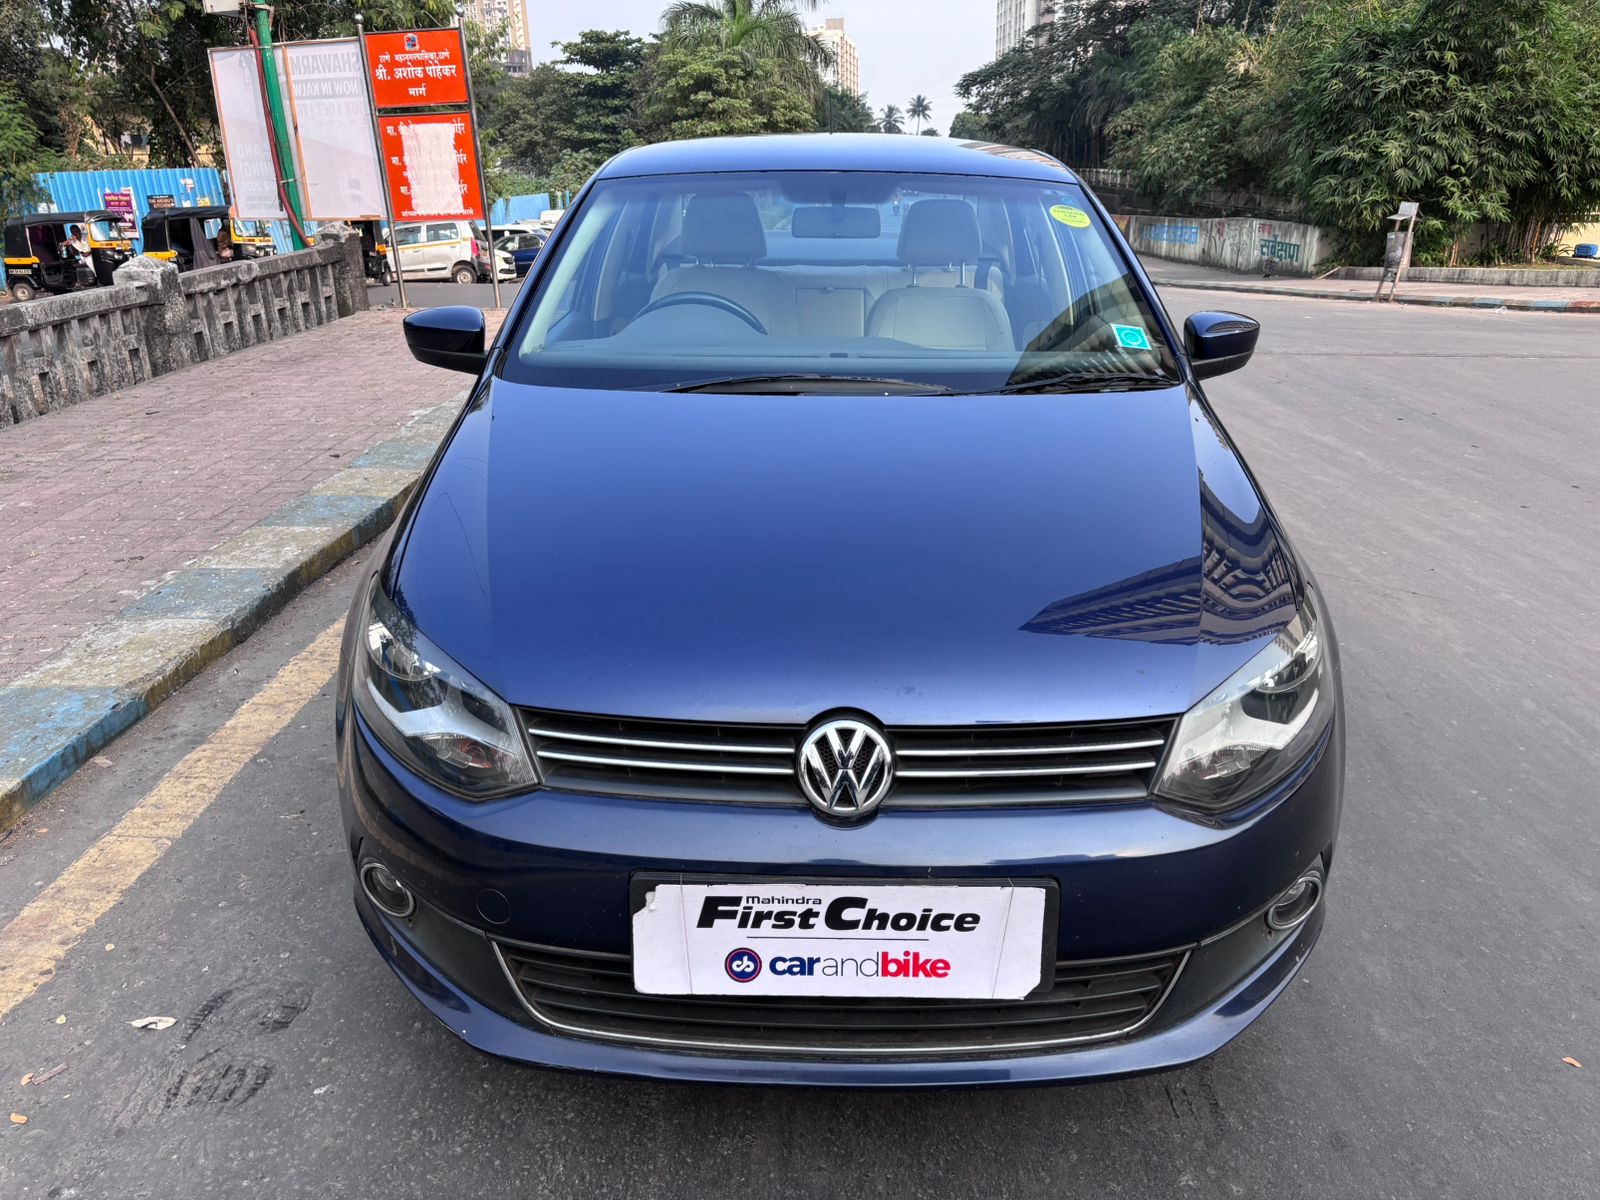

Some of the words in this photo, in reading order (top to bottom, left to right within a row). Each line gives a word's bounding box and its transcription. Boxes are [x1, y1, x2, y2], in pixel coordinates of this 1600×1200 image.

[375, 63, 391, 80] श्री.
[394, 62, 424, 79] अशोक
[425, 60, 457, 79] पोहेकर
[408, 83, 427, 96] मार्ग
[1260, 233, 1301, 262] सर्वेक्षण
[746, 895, 822, 905] Mahindra
[696, 895, 820, 930] First
[824, 896, 981, 932] Choice
[768, 950, 951, 978] carandbike
